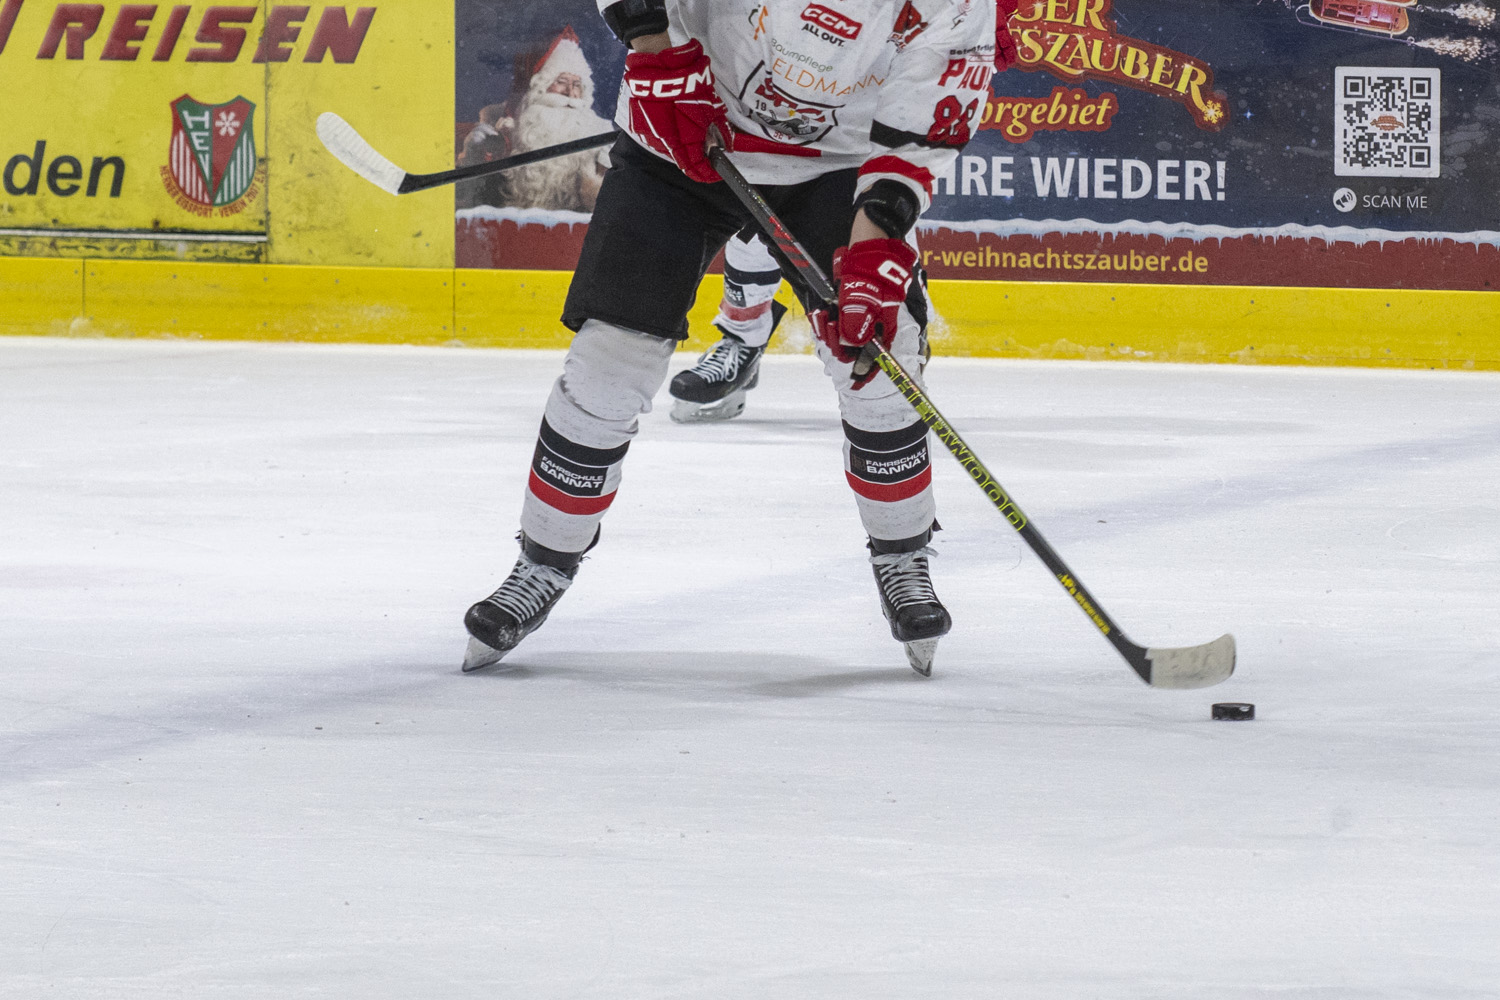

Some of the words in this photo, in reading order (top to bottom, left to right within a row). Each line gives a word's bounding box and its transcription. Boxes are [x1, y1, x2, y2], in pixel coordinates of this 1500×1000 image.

[36, 3, 377, 64] REISEN
[801, 23, 820, 37] ALL
[803, 7, 858, 35] CCM
[629, 65, 712, 98] CCM
[771, 56, 885, 96] ELDMANN
[3, 140, 125, 198] den
[1031, 157, 1226, 201] WIEDER!
[1362, 195, 1401, 208] SCAN
[1406, 195, 1428, 209] ME
[918, 246, 1208, 273] r-weihnachtszauber.de
[542, 456, 604, 480] FAHRSCHULE
[865, 446, 926, 467] FAHRSCHULE
[866, 452, 927, 475] BANNAT
[540, 461, 603, 488] BANNAT
